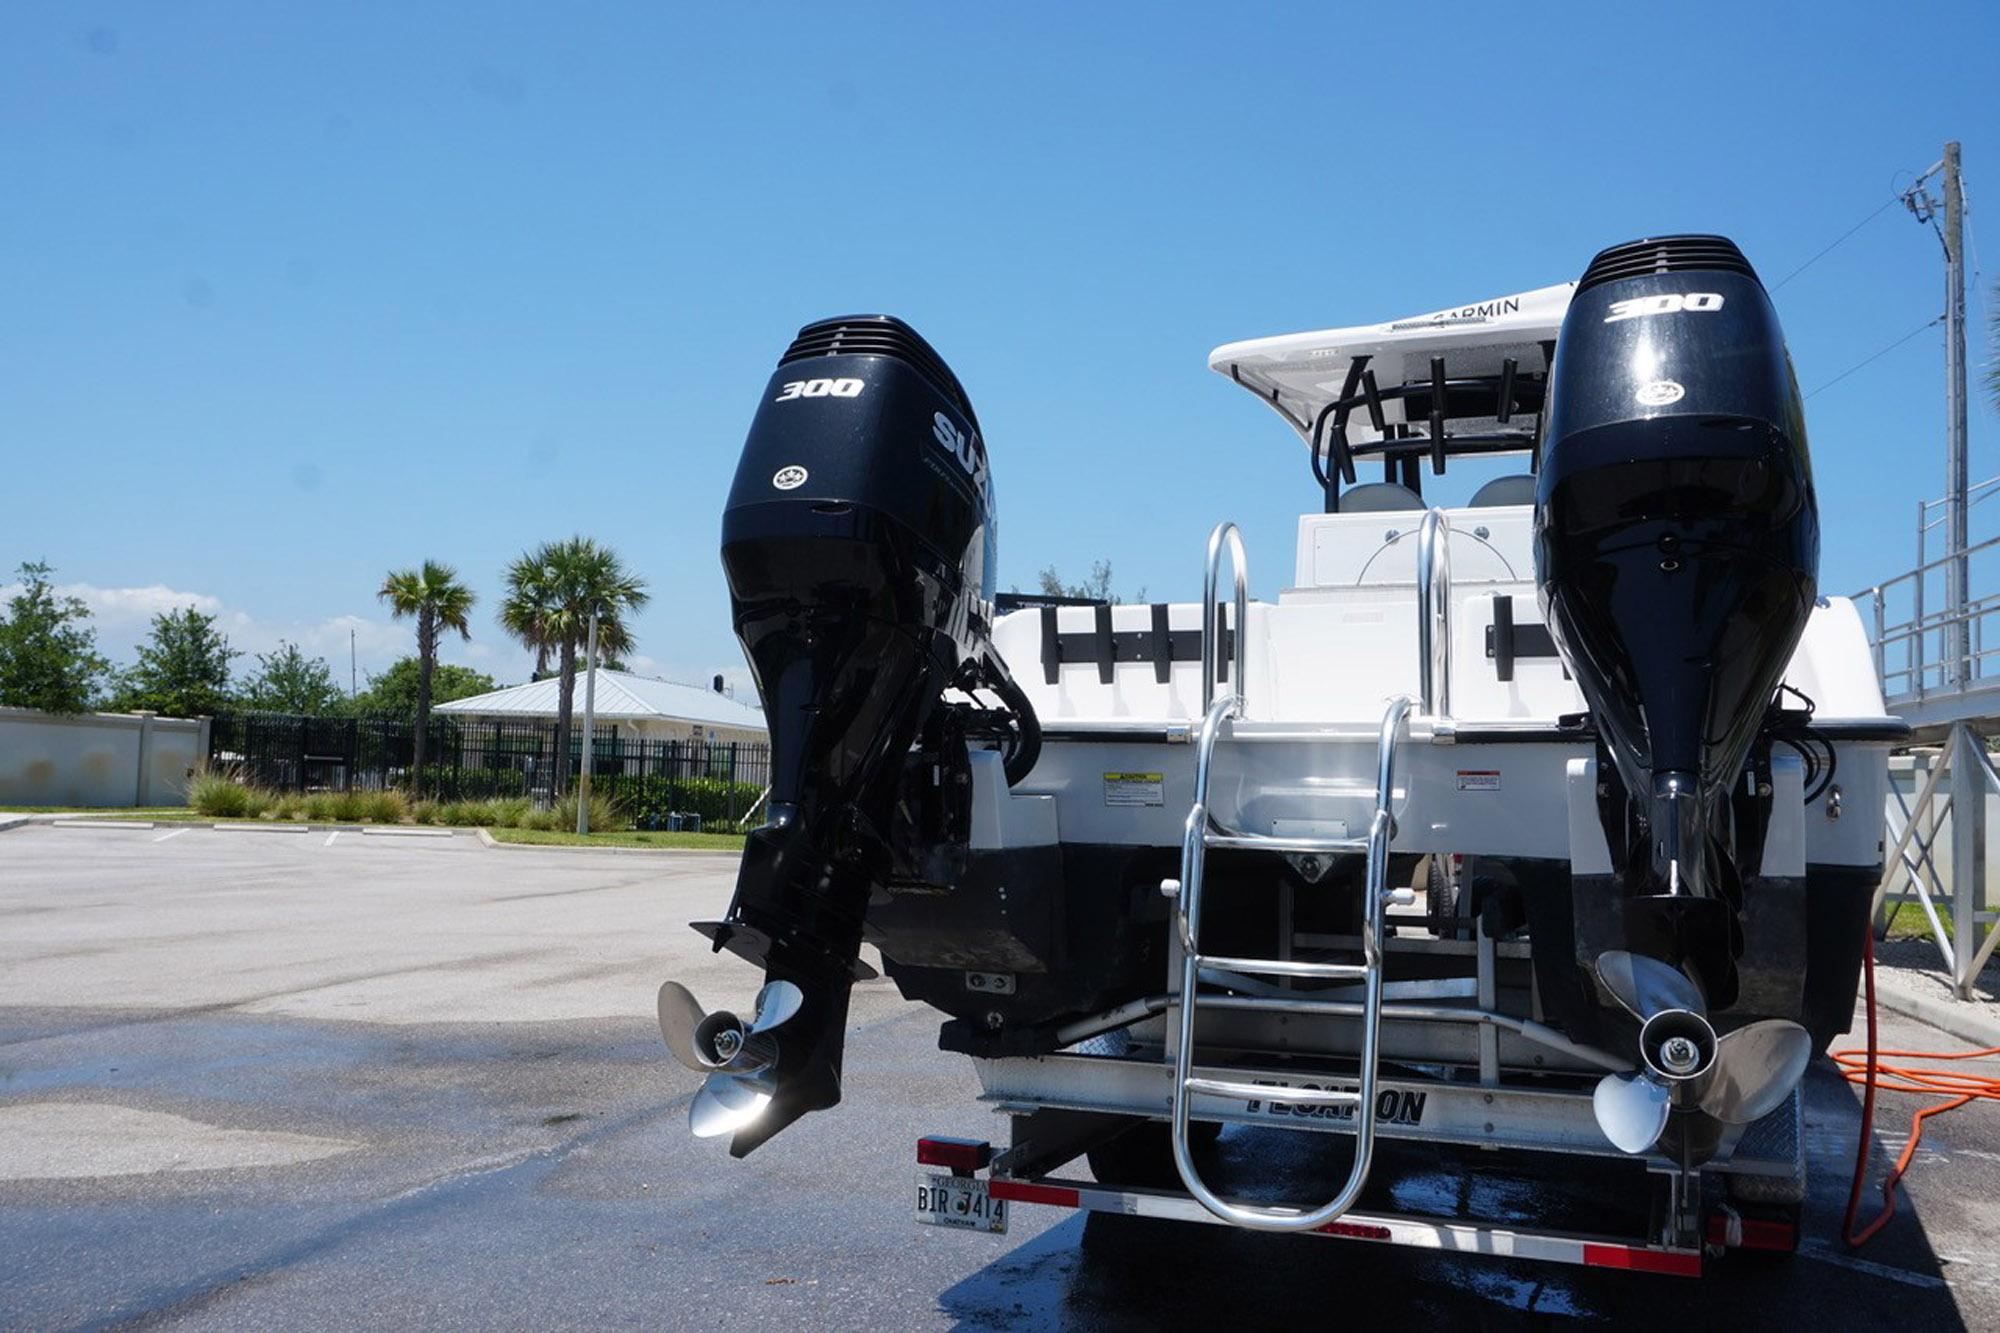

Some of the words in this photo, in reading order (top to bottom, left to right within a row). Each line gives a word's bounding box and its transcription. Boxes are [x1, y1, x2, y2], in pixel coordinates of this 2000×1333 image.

[1603, 293, 1725, 323] 300
[775, 378, 865, 401] 300
[918, 1187, 948, 1213] BIR
[961, 1192, 1003, 1220] 7414
